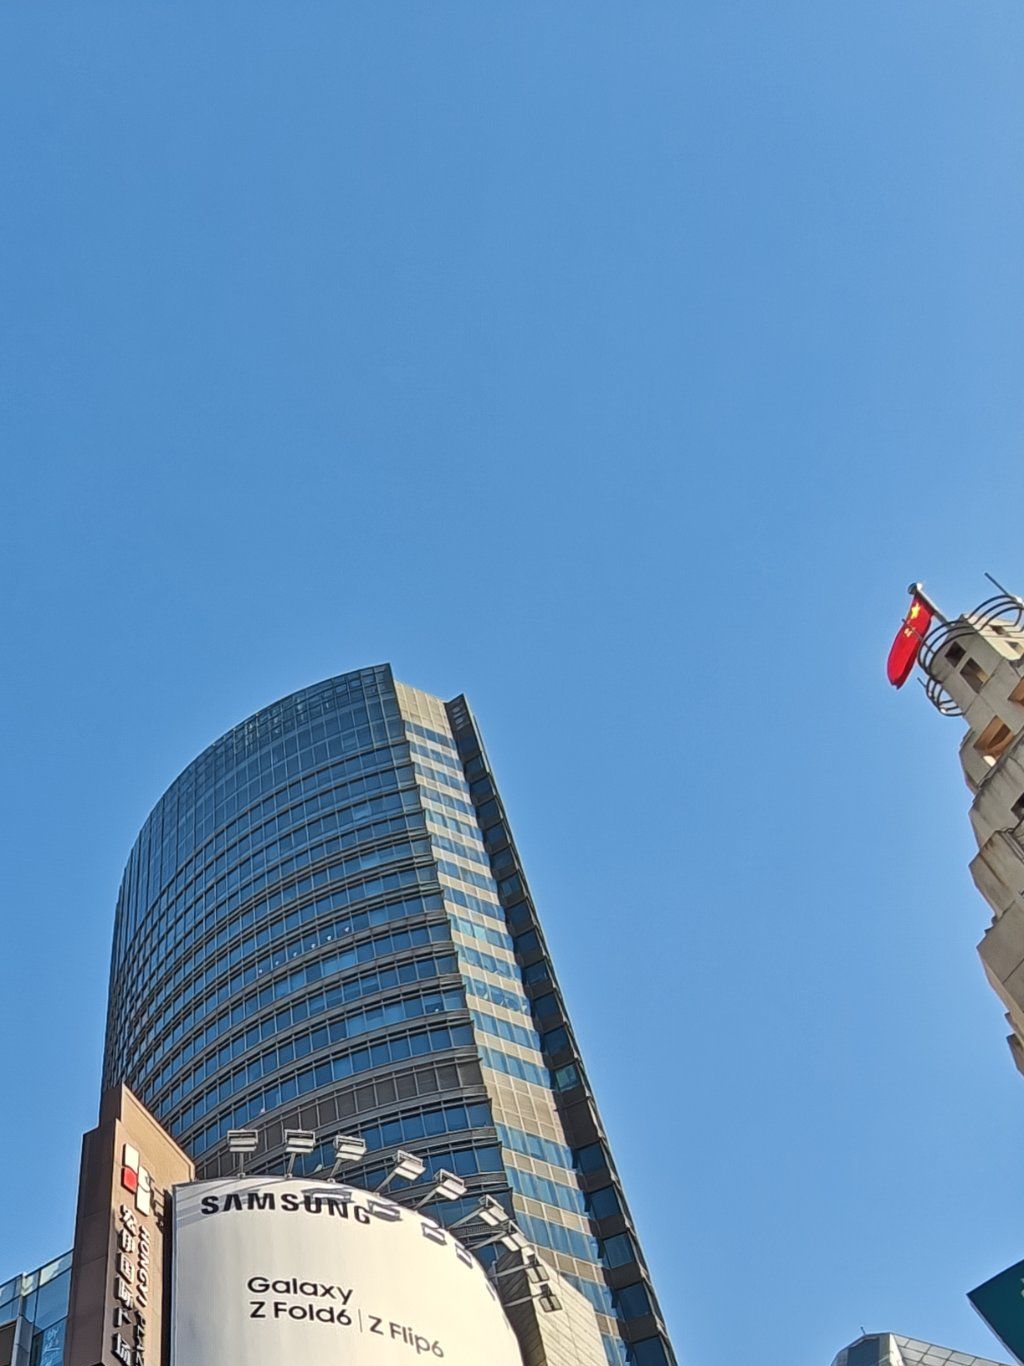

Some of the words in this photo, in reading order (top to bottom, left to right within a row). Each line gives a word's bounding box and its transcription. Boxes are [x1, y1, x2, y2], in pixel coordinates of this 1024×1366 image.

[201, 1192, 371, 1225] SAMSUNG
[136, 1225, 150, 1307] HONGYI
[247, 1276, 353, 1305] Galaxy
[249, 1301, 266, 1319] Z
[274, 1301, 352, 1326] Fold6
[368, 1314, 384, 1336] Z
[389, 1322, 445, 1358] Flip6
